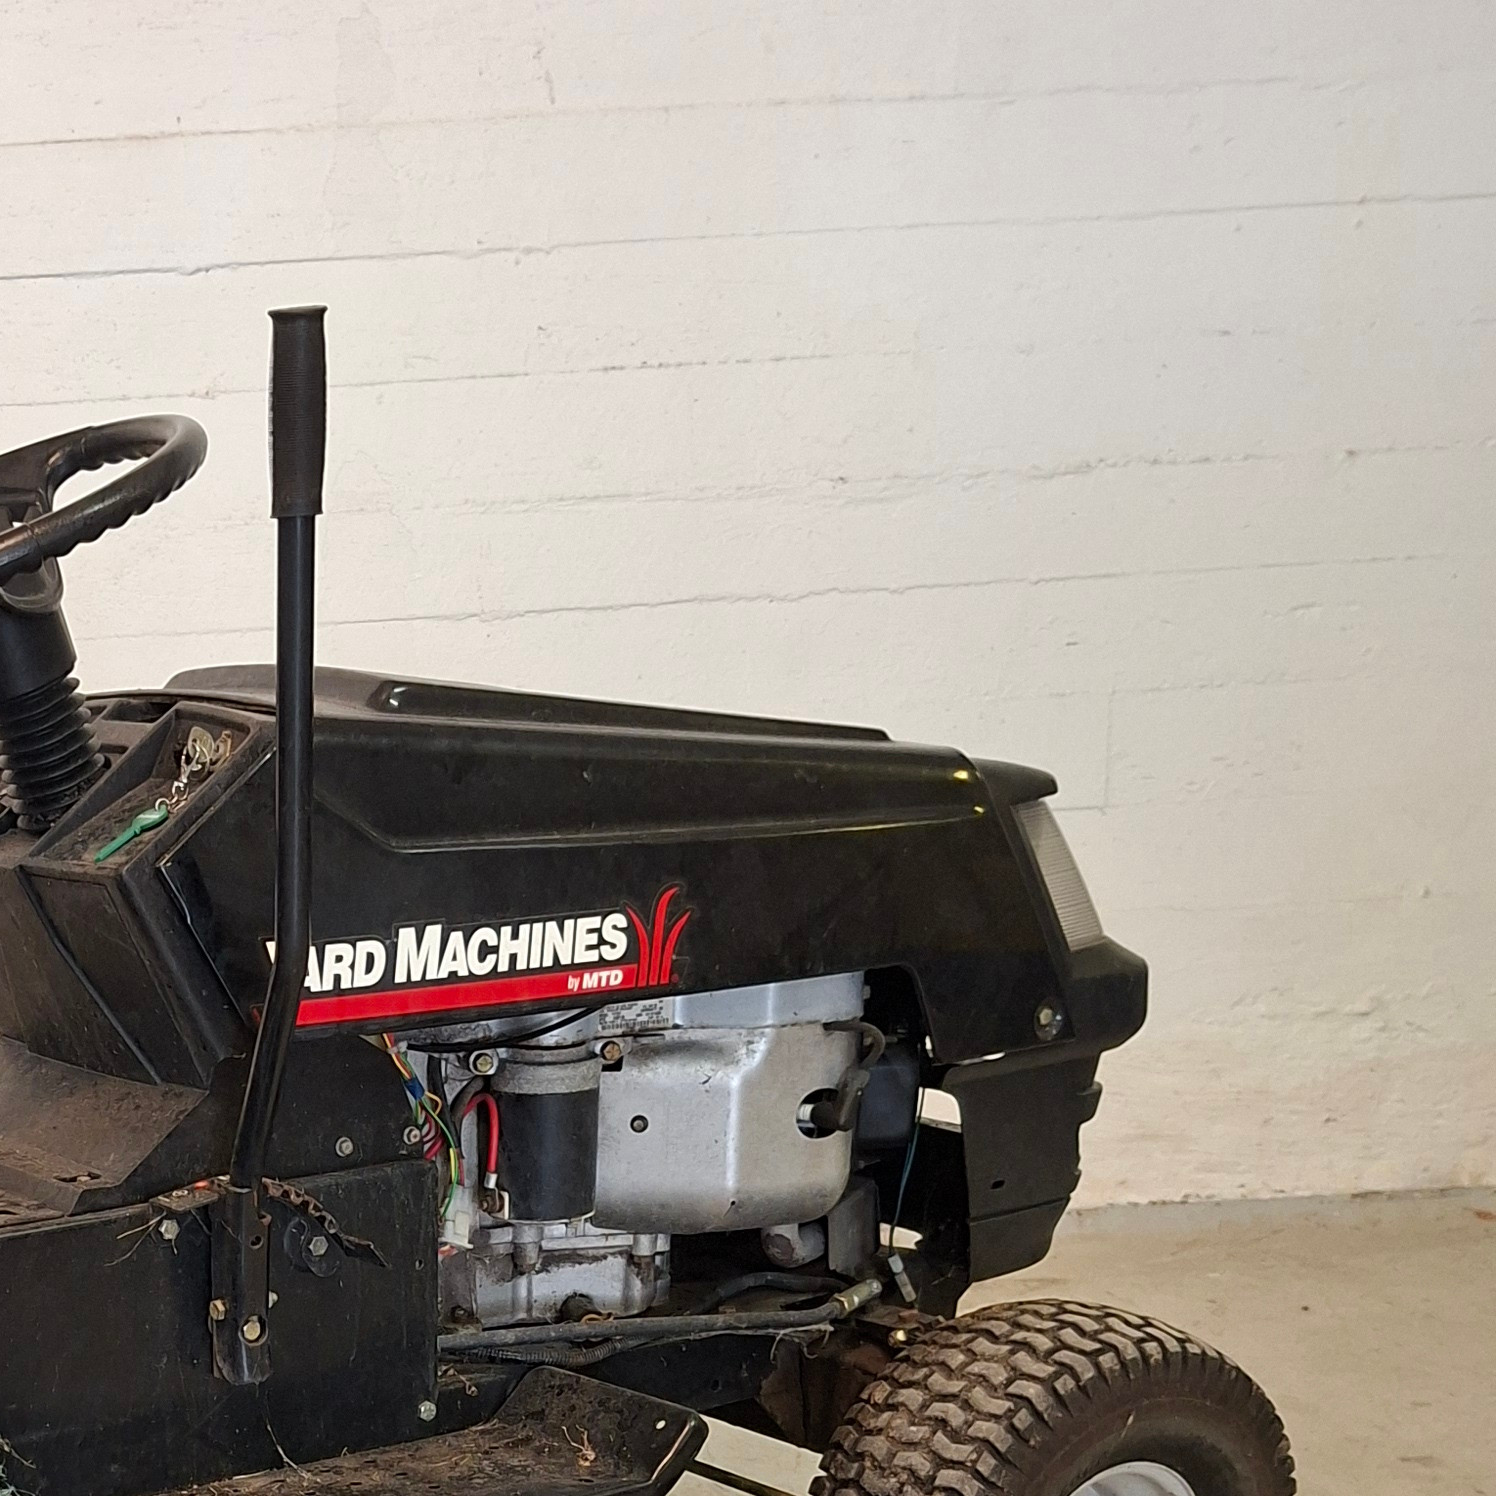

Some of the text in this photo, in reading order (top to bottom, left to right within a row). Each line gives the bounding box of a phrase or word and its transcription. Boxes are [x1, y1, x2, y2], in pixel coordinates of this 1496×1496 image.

[265, 940, 387, 993] ARD
[567, 969, 624, 992] by MTD
